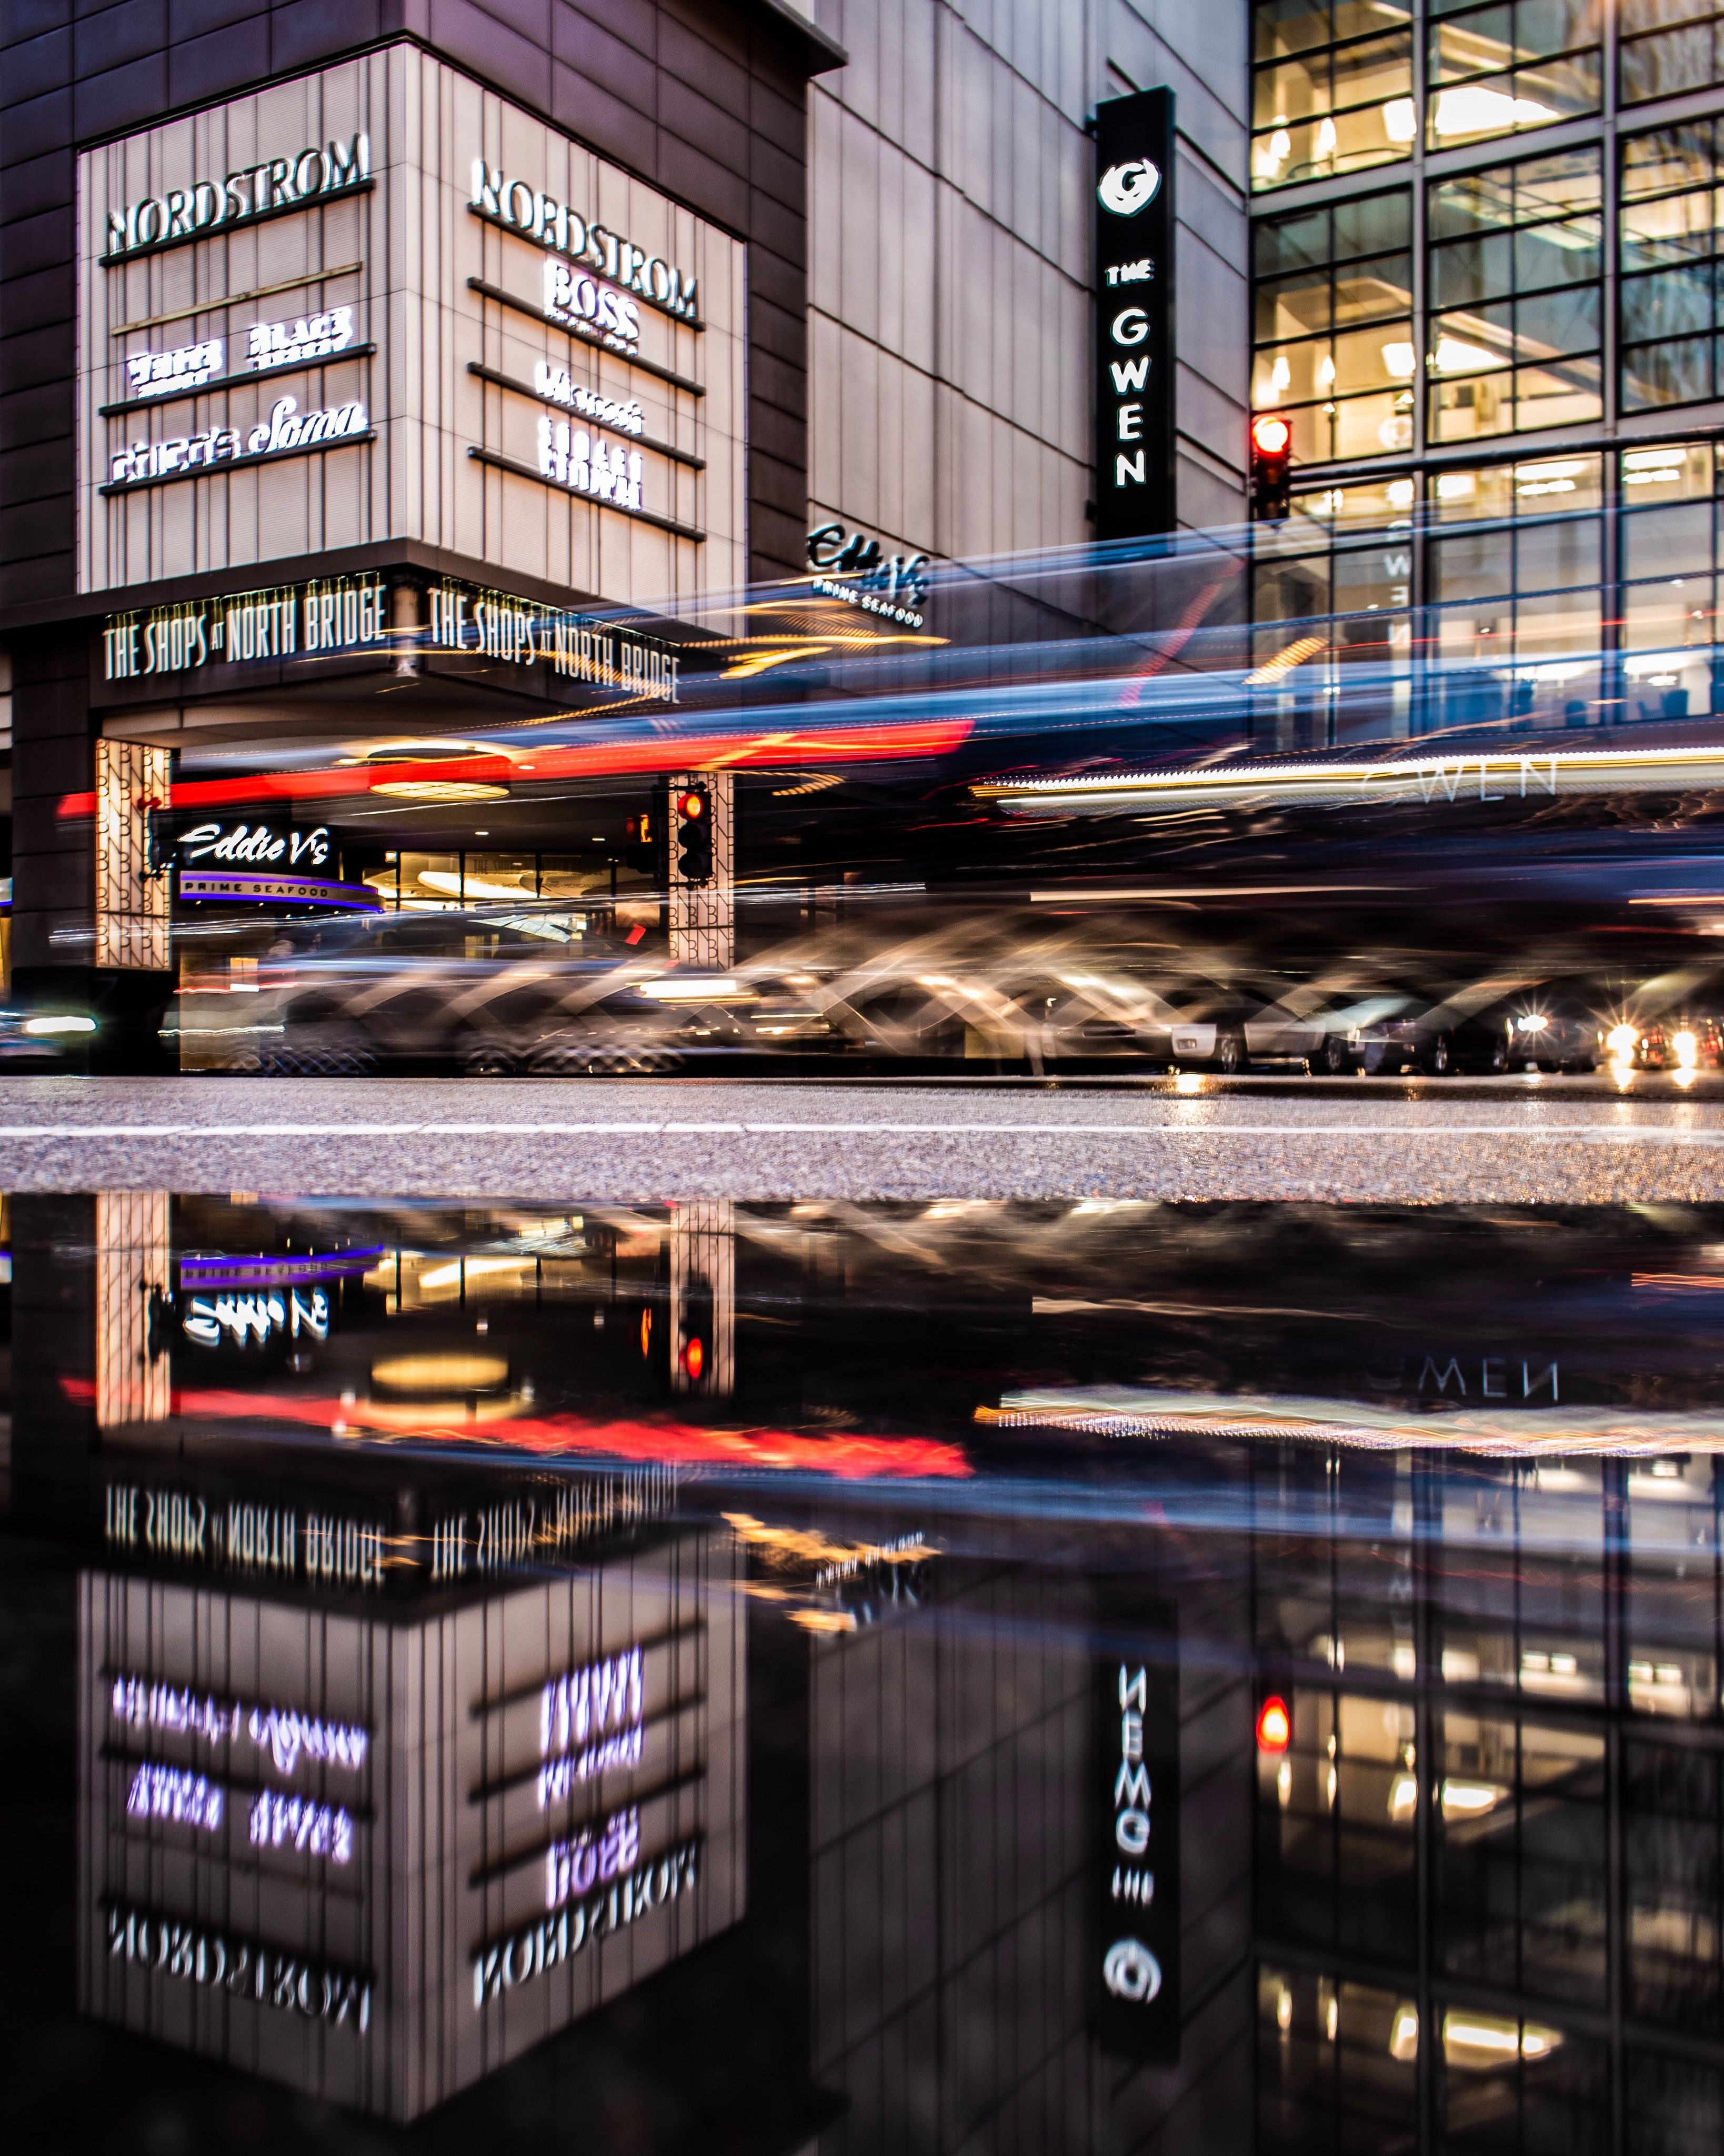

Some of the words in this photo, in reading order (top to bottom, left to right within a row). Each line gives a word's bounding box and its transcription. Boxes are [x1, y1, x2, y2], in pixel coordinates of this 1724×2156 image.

[107, 132, 369, 256] NORDSTROM
[470, 158, 699, 319] NORDSTROM
[544, 258, 639, 340] BOSS
[1106, 258, 1154, 286] THE
[1109, 307, 1151, 487] GWEN
[103, 623, 141, 680] THE
[144, 613, 207, 674] SHOPS
[211, 621, 225, 651] AT
[226, 600, 296, 663] NORTH
[304, 585, 387, 651] BRIDGE
[427, 587, 468, 650] THE
[475, 601, 536, 665] SHOPS
[554, 622, 614, 687] NORTH
[177, 824, 285, 862] Eddie
[290, 827, 330, 865] V's
[185, 882, 243, 893] PRIME
[253, 884, 328, 898] SEAFOOD
